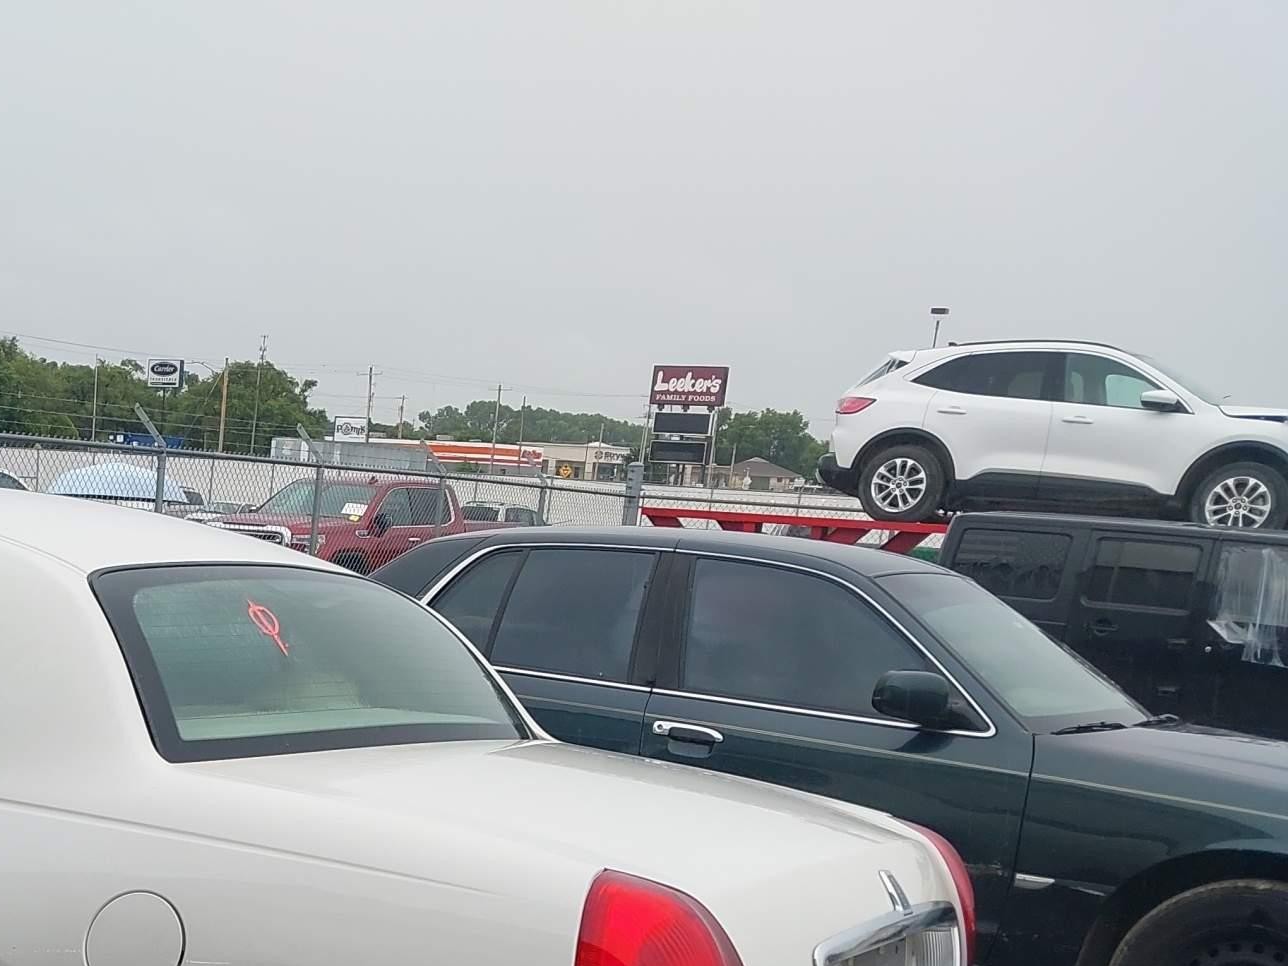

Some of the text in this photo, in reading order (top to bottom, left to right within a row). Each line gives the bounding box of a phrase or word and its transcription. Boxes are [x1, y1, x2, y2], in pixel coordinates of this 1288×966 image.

[153, 365, 176, 373] Carrier
[654, 371, 721, 393] Leeker's
[656, 393, 687, 401] FAMILY
